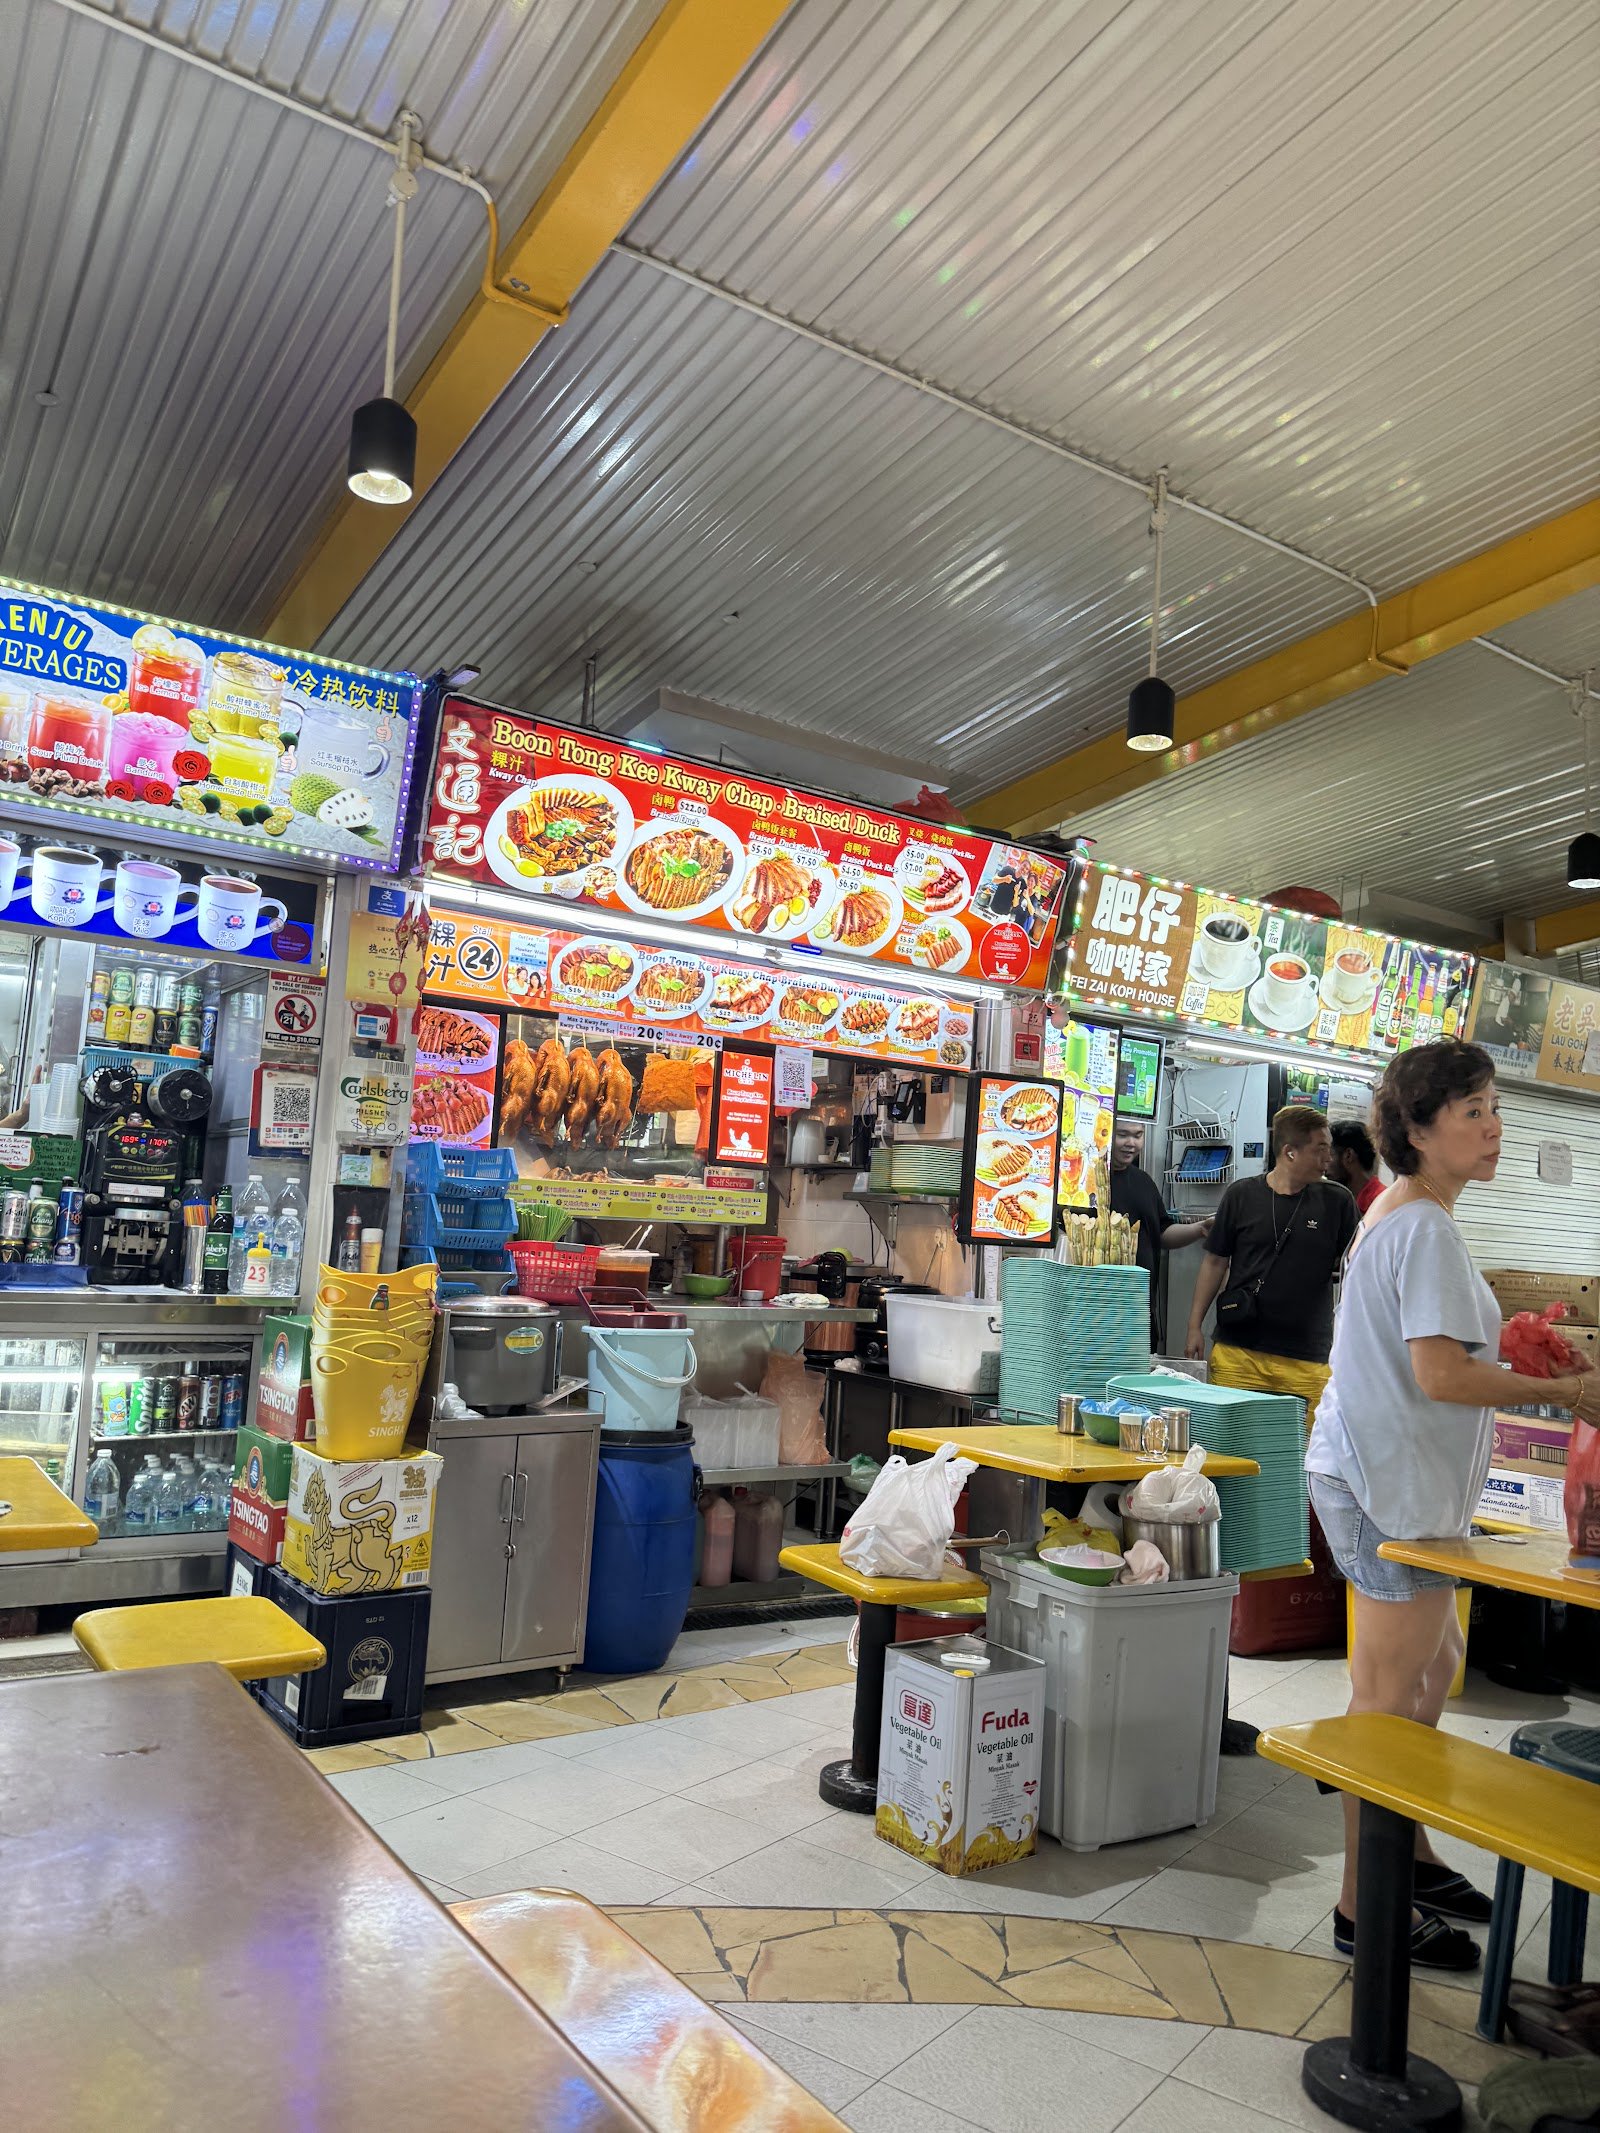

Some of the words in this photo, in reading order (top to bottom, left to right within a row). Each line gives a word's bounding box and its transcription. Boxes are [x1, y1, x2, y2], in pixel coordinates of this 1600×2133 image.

[135, 682, 149, 692] Ice
[150, 686, 180, 699] Lemon
[181, 691, 197, 703] Tea
[291, 668, 399, 717] 冷热饮料
[211, 700, 236, 714] Honey
[237, 706, 258, 717] Lime
[4, 741, 28, 753] Drink
[31, 748, 53, 760] Sour
[54, 751, 79, 765] Plum
[79, 755, 104, 768] Drink
[490, 750, 526, 772] 粿汁
[124, 765, 164, 781] Bandung
[310, 758, 342, 772] Soursop
[343, 765, 364, 776] Drink
[488, 767, 514, 784] Kway
[514, 772, 539, 790] Chap
[492, 718, 553, 757] Boon
[559, 734, 616, 777] Tong
[618, 753, 658, 784] Kee
[663, 763, 722, 805] Kway
[725, 781, 774, 817] Chap
[783, 796, 851, 832] Braised
[853, 815, 901, 847] Duck
[201, 781, 245, 797] Homemade
[246, 789, 266, 801] Lime
[267, 793, 290, 806] Juice
[680, 800, 707, 816] $22.00
[650, 808, 679, 824] Braised
[679, 813, 701, 828] Duck
[749, 831, 776, 845] Braised
[841, 853, 866, 867] Braised
[866, 859, 884, 870] Duck
[906, 849, 925, 861] $5.00
[904, 862, 923, 873] $7.00
[1091, 874, 1183, 945] 肥仔
[47, 913, 67, 924] Kopi
[133, 926, 150, 935] Milo
[471, 925, 494, 936] Stall
[215, 939, 228, 948] Teh
[229, 941, 237, 949] O
[427, 920, 457, 982] 粿汁
[465, 946, 496, 973] 24
[1085, 937, 1172, 988] 咖啡家
[637, 951, 667, 963] Boon
[669, 955, 696, 971] Tong
[698, 960, 718, 973] Kee
[720, 965, 750, 980] Kway
[752, 970, 778, 985] Chap
[781, 974, 817, 989] Braised
[819, 982, 845, 995] Duck
[847, 987, 886, 1002] Original
[887, 993, 909, 1005] Stall
[1070, 975, 1088, 990] FEI
[1089, 979, 1109, 994] ZAI
[1110, 982, 1137, 1000] KOPI
[1138, 989, 1177, 1009] HOUSE
[1186, 996, 1205, 1011] Coffee
[283, 1016, 294, 1025] 21
[559, 1022, 575, 1031] Kway
[575, 1024, 590, 1034] Chap
[567, 1015, 578, 1023] Max
[584, 1018, 602, 1028] Kway
[619, 1024, 636, 1032] Extra
[296, 1037, 320, 1045] $10,000
[637, 1026, 664, 1041] 20¢
[665, 1031, 679, 1039] Take
[679, 1033, 693, 1041] Away
[1551, 1034, 1565, 1046] LAU
[697, 1035, 722, 1050] 20¢
[724, 1068, 768, 1081] MICHELIN
[341, 1077, 409, 1103] Carlsberg
[356, 1108, 391, 1117] PILSNER
[719, 1148, 764, 1159] MICHELIN
[712, 1178, 725, 1187] Self
[725, 1179, 748, 1188] Service
[32, 1215, 53, 1225] Chang
[247, 1266, 267, 1283] 23
[259, 1385, 296, 1415] TSINGTAO
[233, 1498, 269, 1534] TSINGTAO
[904, 1694, 932, 1726] 富達
[981, 1708, 1030, 1733] Fuda
[890, 1716, 928, 1744] Vegetable
[929, 1736, 942, 1751] Oil
[977, 1737, 1019, 1755] Vegetable
[1020, 1732, 1034, 1745] Oil
[988, 1764, 1005, 1774] Minyak
